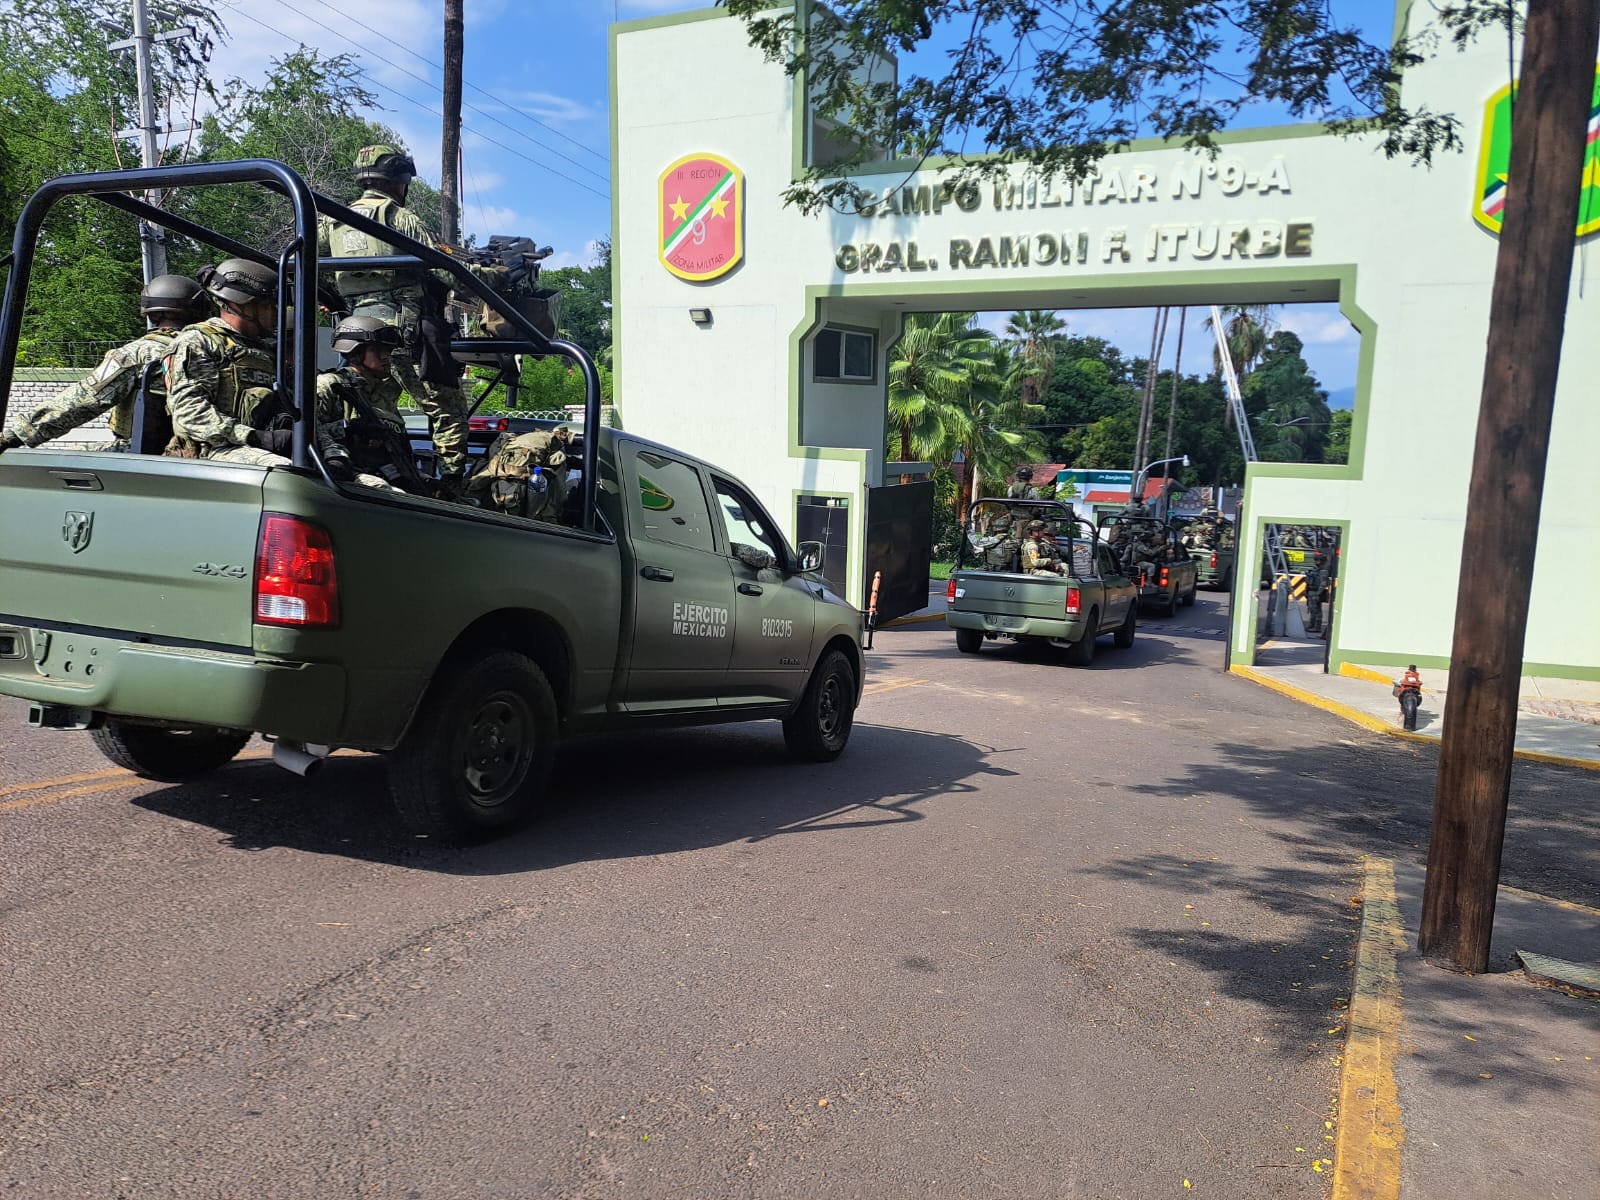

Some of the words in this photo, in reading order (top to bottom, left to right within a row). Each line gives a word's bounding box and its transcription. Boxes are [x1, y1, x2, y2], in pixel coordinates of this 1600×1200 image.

[856, 178, 982, 218] CAMPO
[993, 163, 1159, 211] MILITAR
[692, 219, 706, 245] 9
[835, 241, 939, 273] GRAL.
[949, 231, 1089, 270] RAMON
[1102, 225, 1131, 264] F.
[1145, 218, 1315, 262] ITURBE
[696, 253, 725, 270] MILITAR
[672, 601, 728, 625] EJÉRCITO
[672, 621, 726, 638] MEXICANO
[761, 617, 793, 638] 8103315
